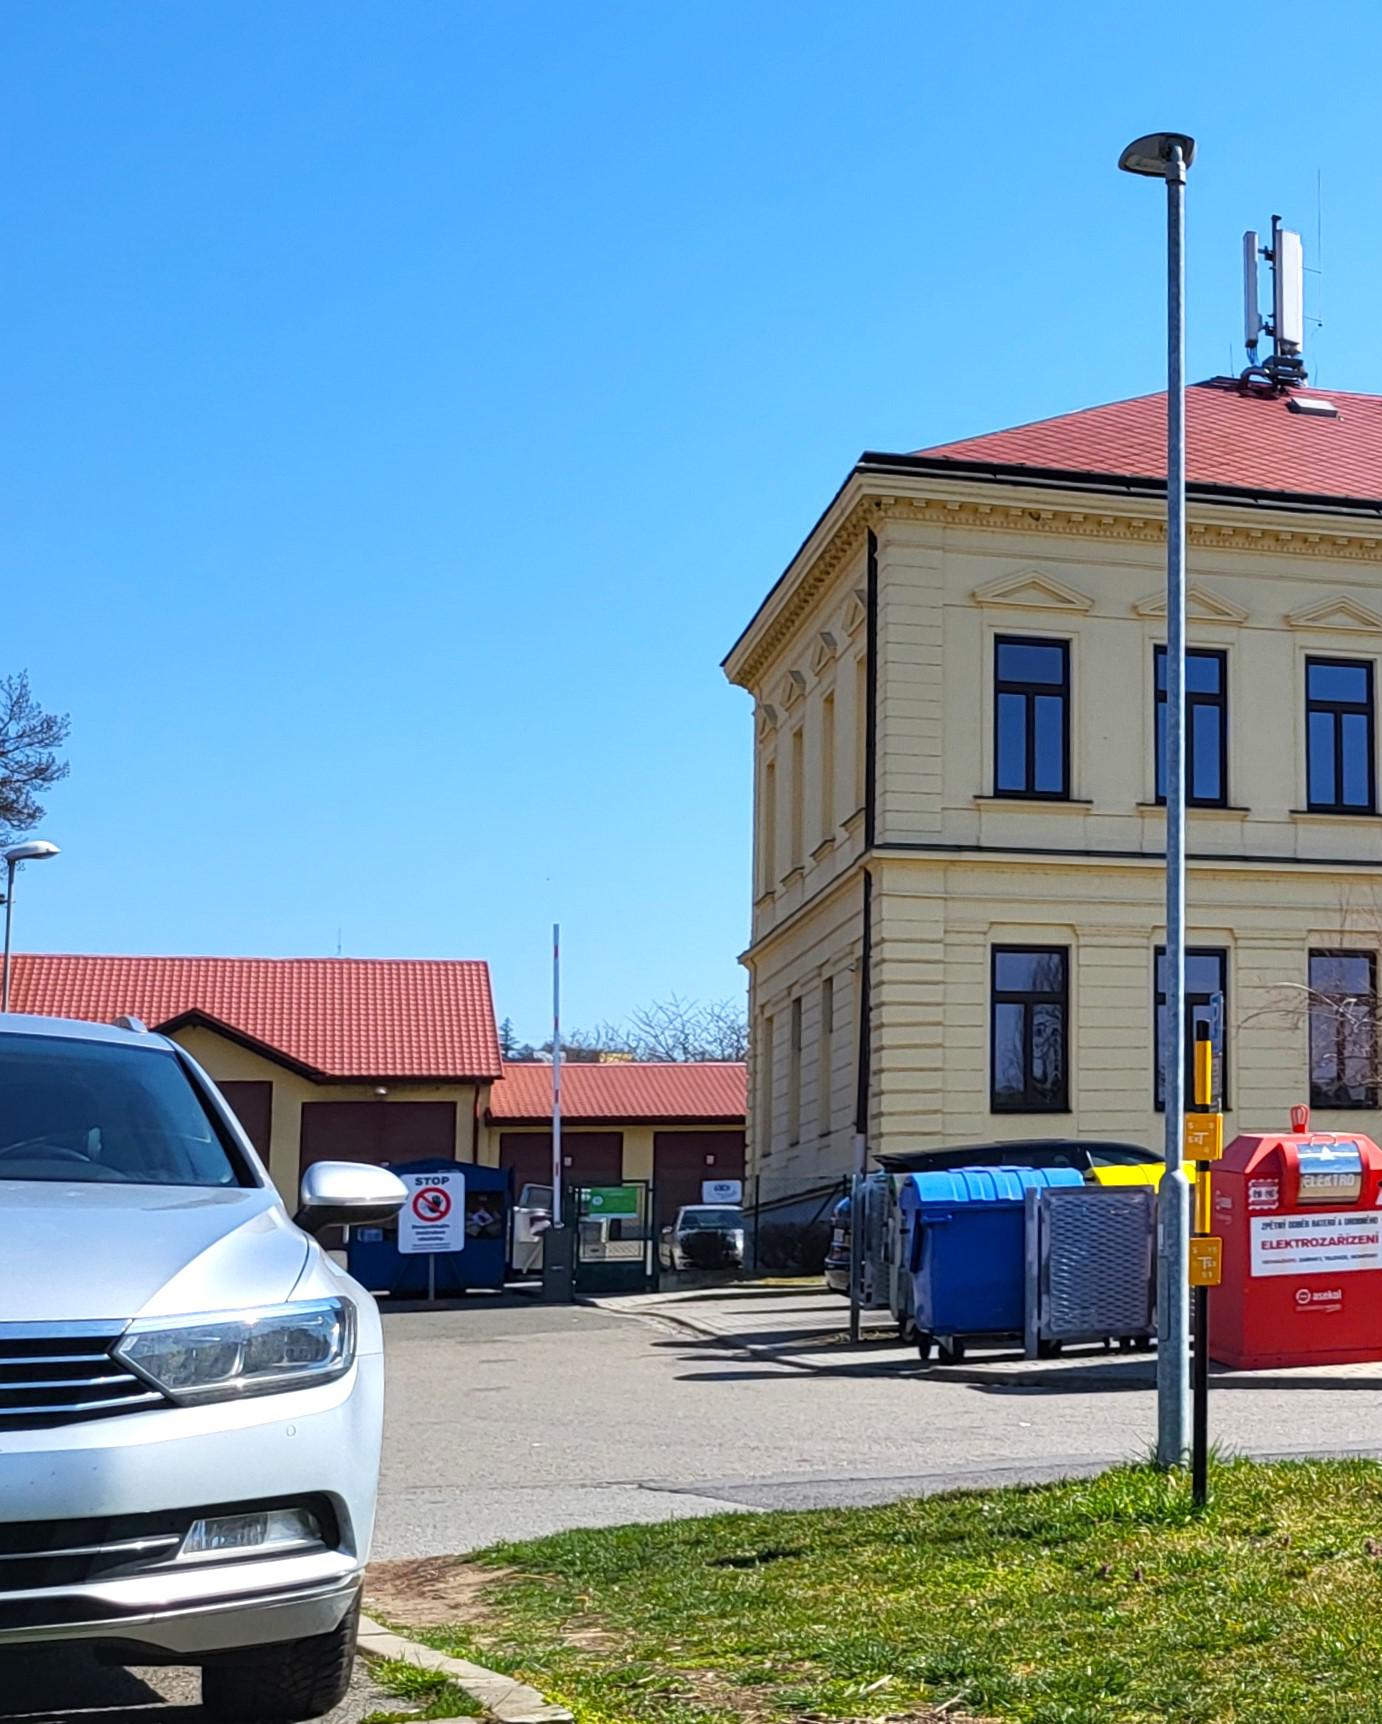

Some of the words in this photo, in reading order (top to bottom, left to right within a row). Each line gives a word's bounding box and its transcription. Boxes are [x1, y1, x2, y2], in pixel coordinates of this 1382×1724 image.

[415, 1176, 450, 1186] STOP
[1302, 1174, 1355, 1188] ELEKTRO
[1261, 1231, 1379, 1251] ELEKTROZAŘÍZENÍ
[1312, 1288, 1342, 1301] asekol
